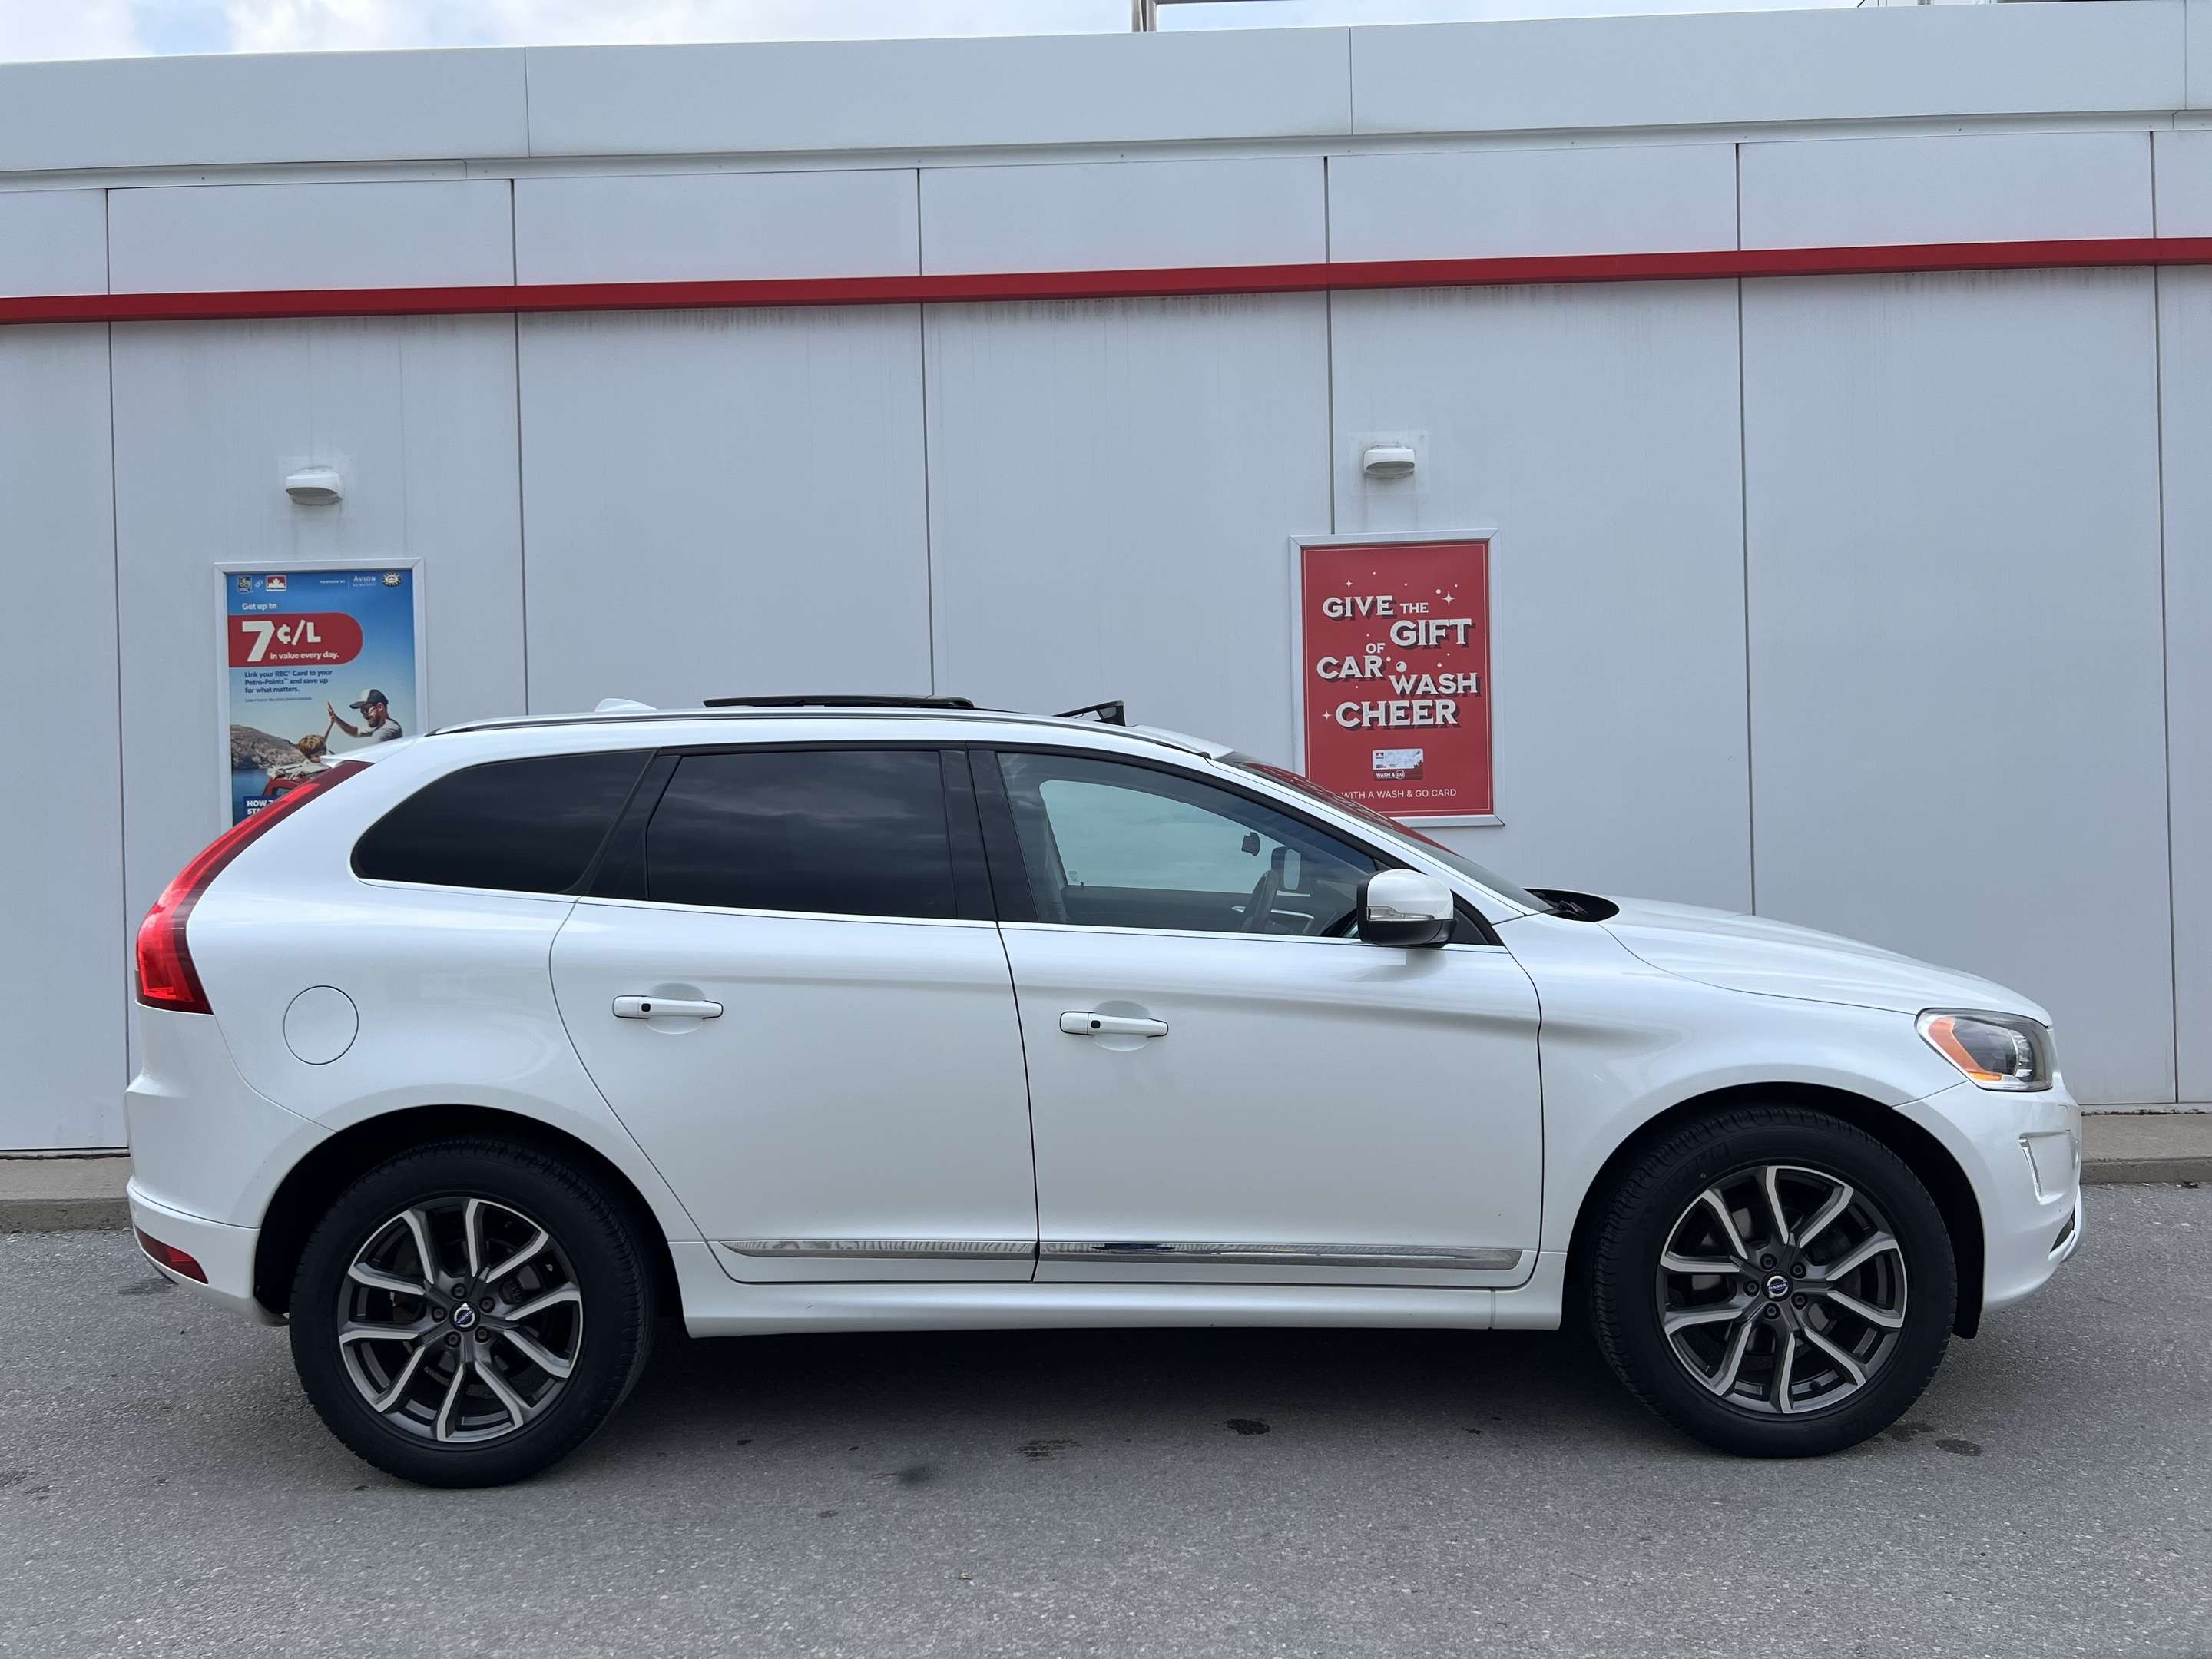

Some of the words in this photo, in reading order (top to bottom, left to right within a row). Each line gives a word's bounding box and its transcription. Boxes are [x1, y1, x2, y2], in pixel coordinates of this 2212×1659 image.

[1322, 595, 1395, 618] GIVE
[1399, 602, 1429, 614] THE
[1389, 618, 1472, 646] GIFT
[323, 651, 339, 660] day.
[1366, 643, 1386, 654] OF
[1316, 655, 1383, 679] CAR
[1388, 672, 1478, 695] WASH
[1335, 699, 1458, 727] CHEER
[1342, 791, 1366, 800] WITH
[1376, 790, 1404, 799] WASH
[1406, 790, 1413, 798] &
[1431, 789, 1457, 797] CARD
